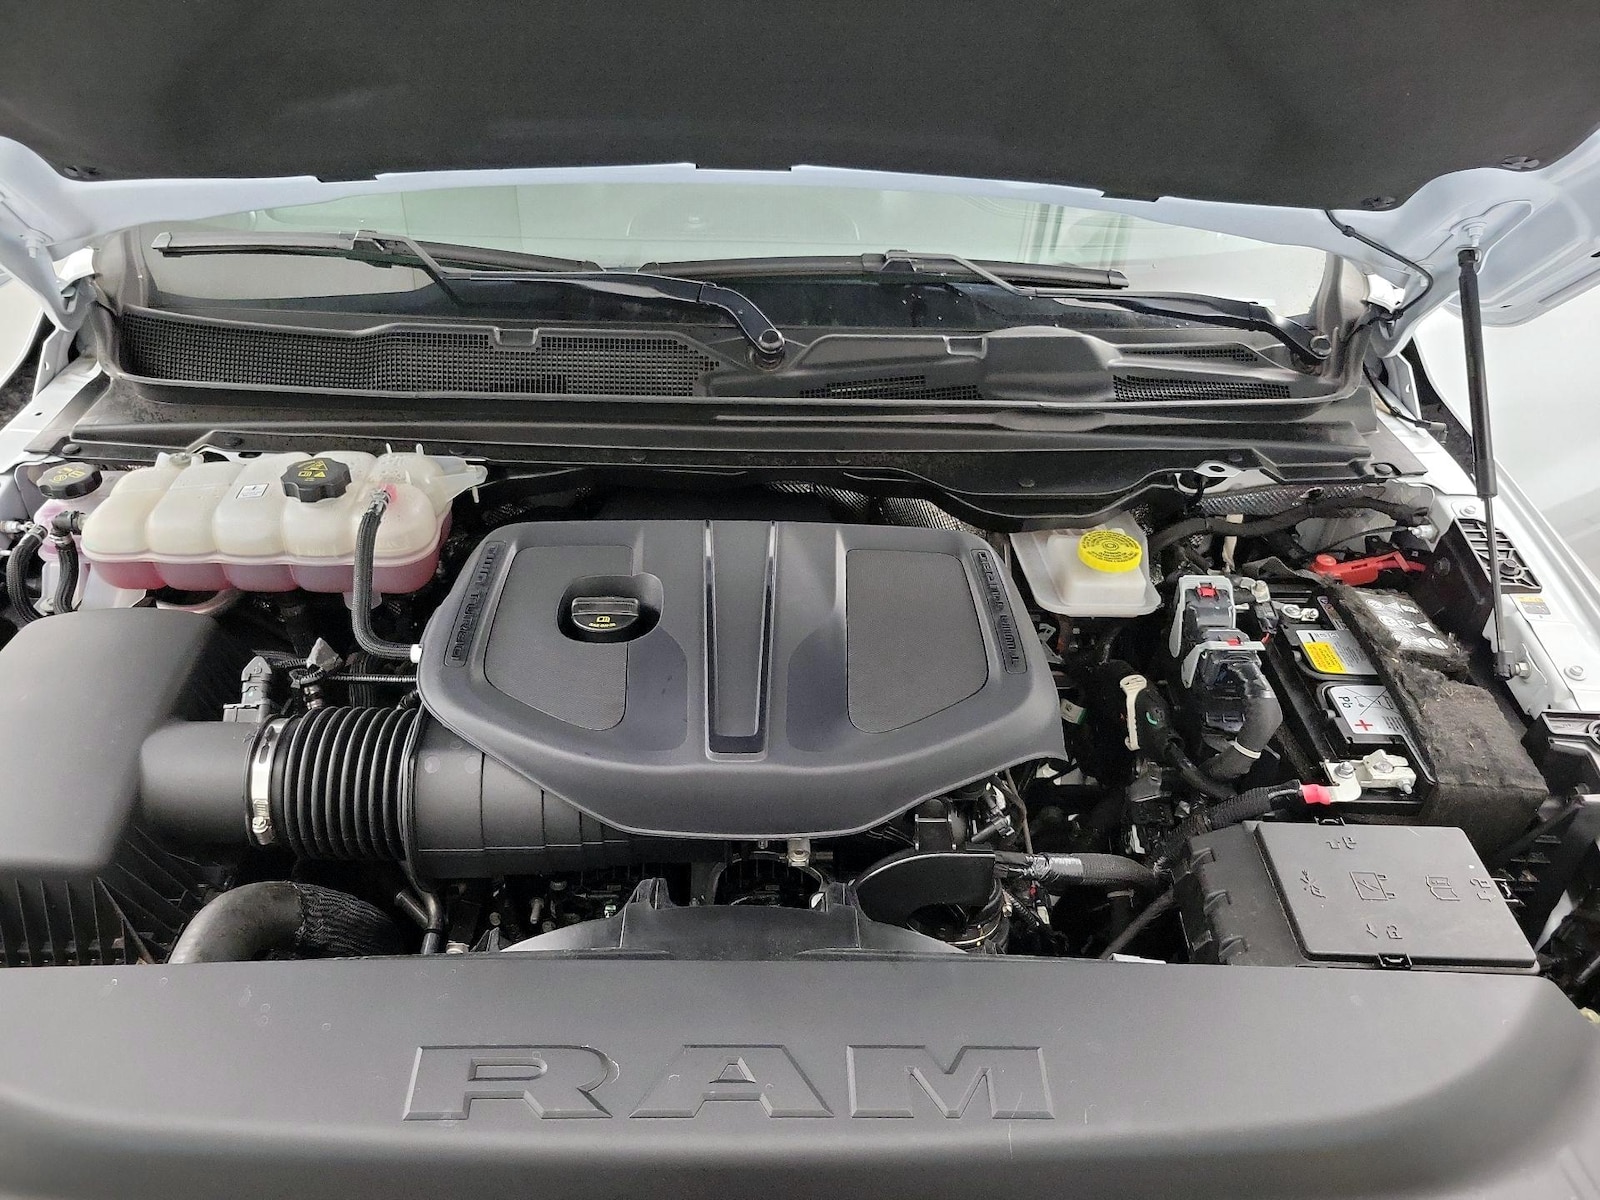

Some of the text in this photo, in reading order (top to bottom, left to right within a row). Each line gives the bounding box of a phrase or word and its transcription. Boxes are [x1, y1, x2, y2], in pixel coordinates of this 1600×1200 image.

[451, 593, 481, 661] TURBO
[1338, 696, 1353, 709] Pb
[402, 1044, 1055, 1120] RAM
